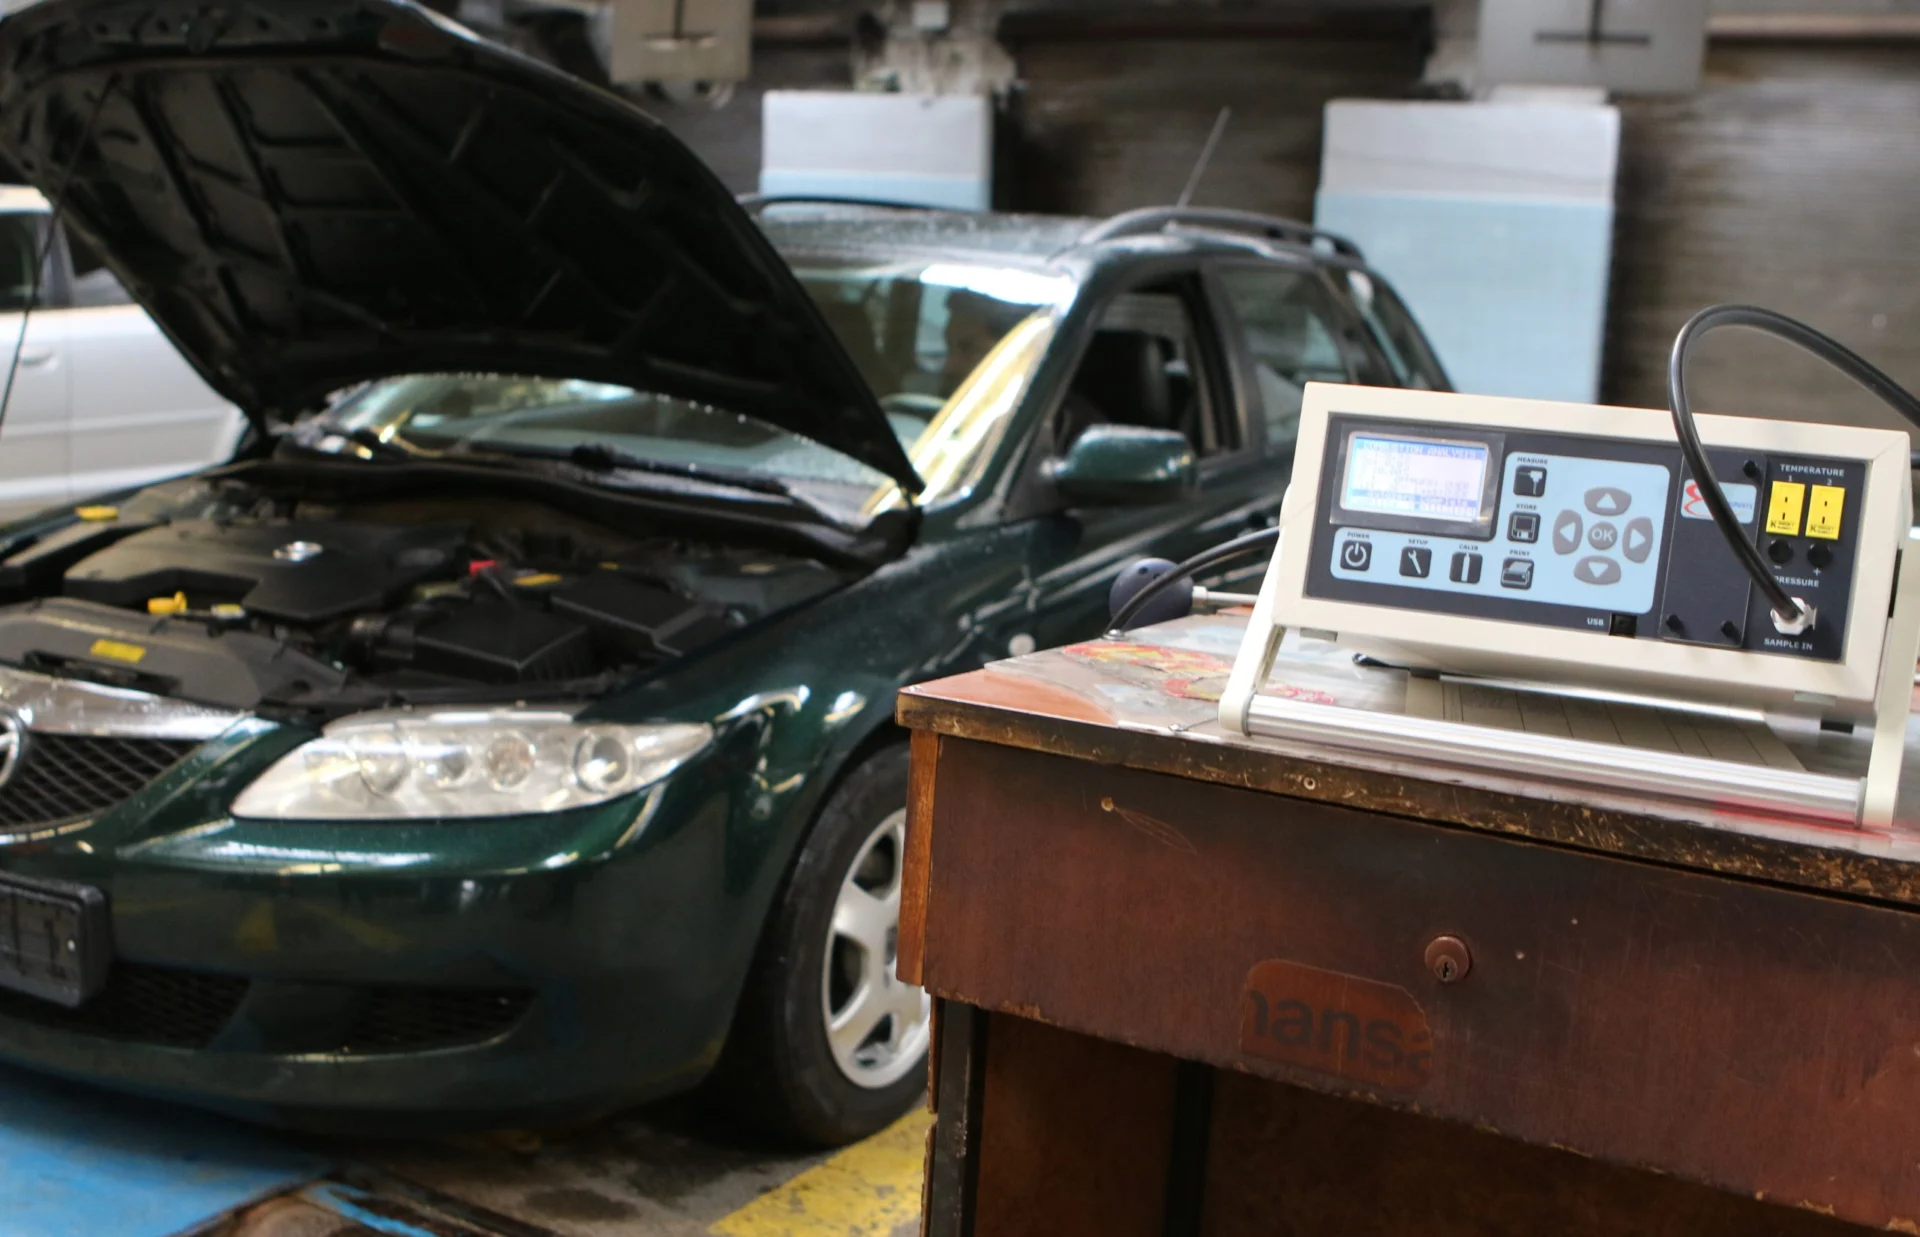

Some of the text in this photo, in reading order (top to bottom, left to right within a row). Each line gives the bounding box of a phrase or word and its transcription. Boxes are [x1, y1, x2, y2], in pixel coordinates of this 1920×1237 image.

[1517, 456, 1548, 465] MEASURE
[1780, 464, 1844, 477] TEMPERATURE
[1347, 531, 1370, 539] POWER
[1591, 527, 1613, 541] OK
[1458, 543, 1479, 551] CALIB
[1586, 617, 1604, 627] USB
[1763, 637, 1813, 650] SAMPLE IN
